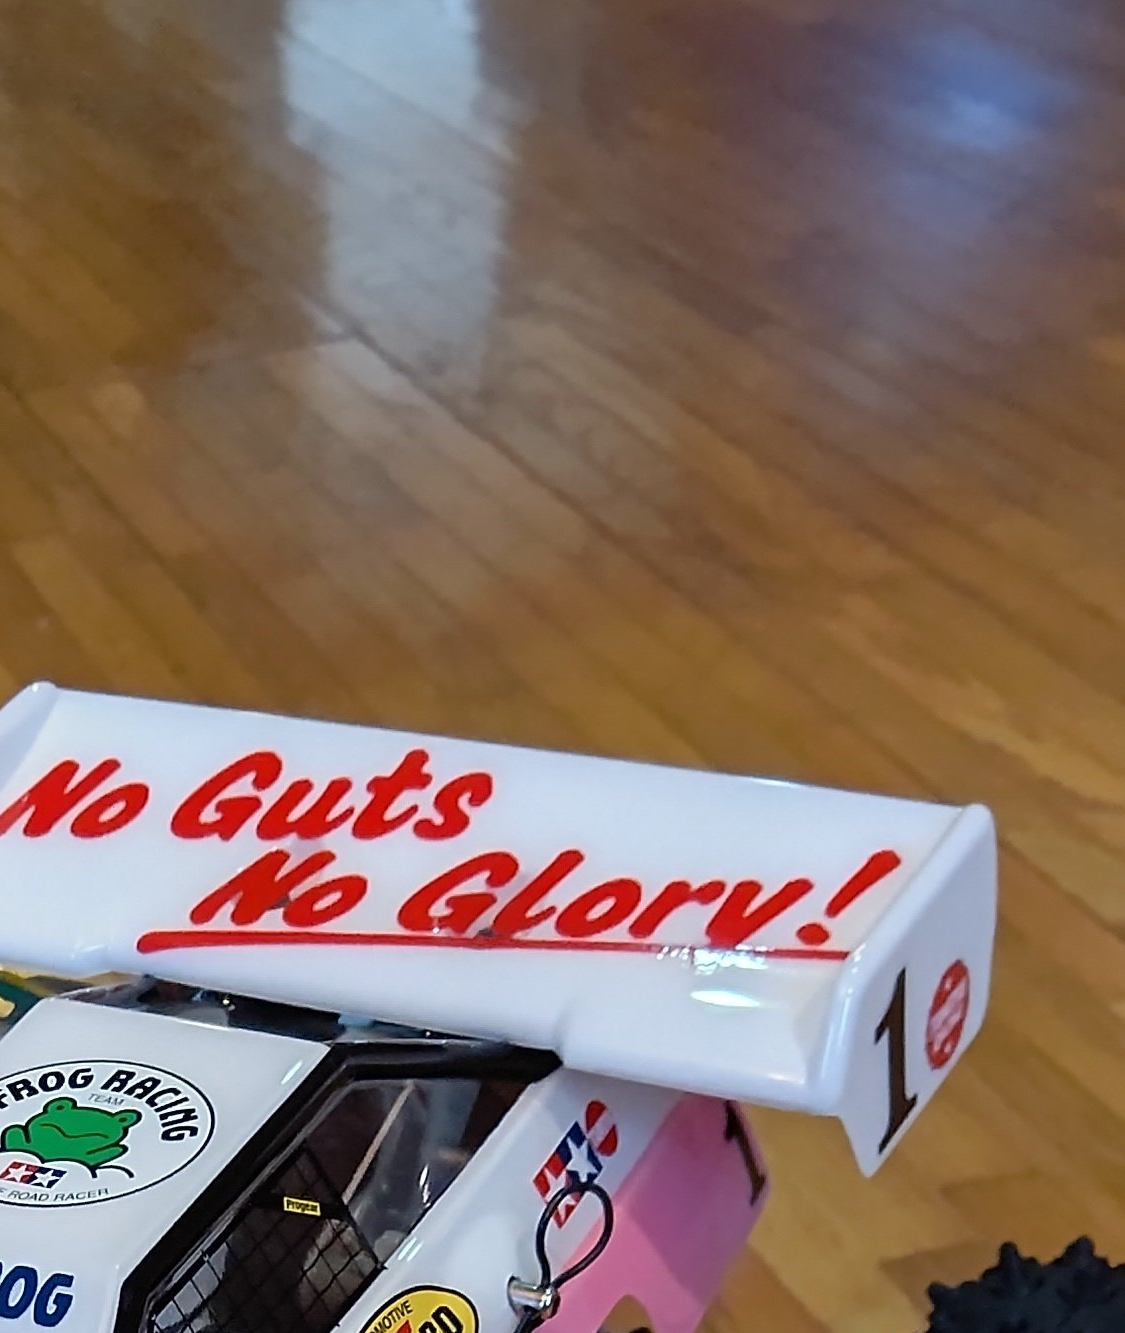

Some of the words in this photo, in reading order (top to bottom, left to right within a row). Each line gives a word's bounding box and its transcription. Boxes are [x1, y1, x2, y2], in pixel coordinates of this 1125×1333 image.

[170, 749, 493, 841] Guts
[190, 850, 368, 926] No
[396, 849, 902, 947] Glory!
[88, 1092, 125, 1106] TEAM
[874, 966, 918, 1155] 1
[100, 1069, 199, 1141] RACING
[7, 1189, 49, 1202] ROAD
[53, 1187, 110, 1202] RACER
